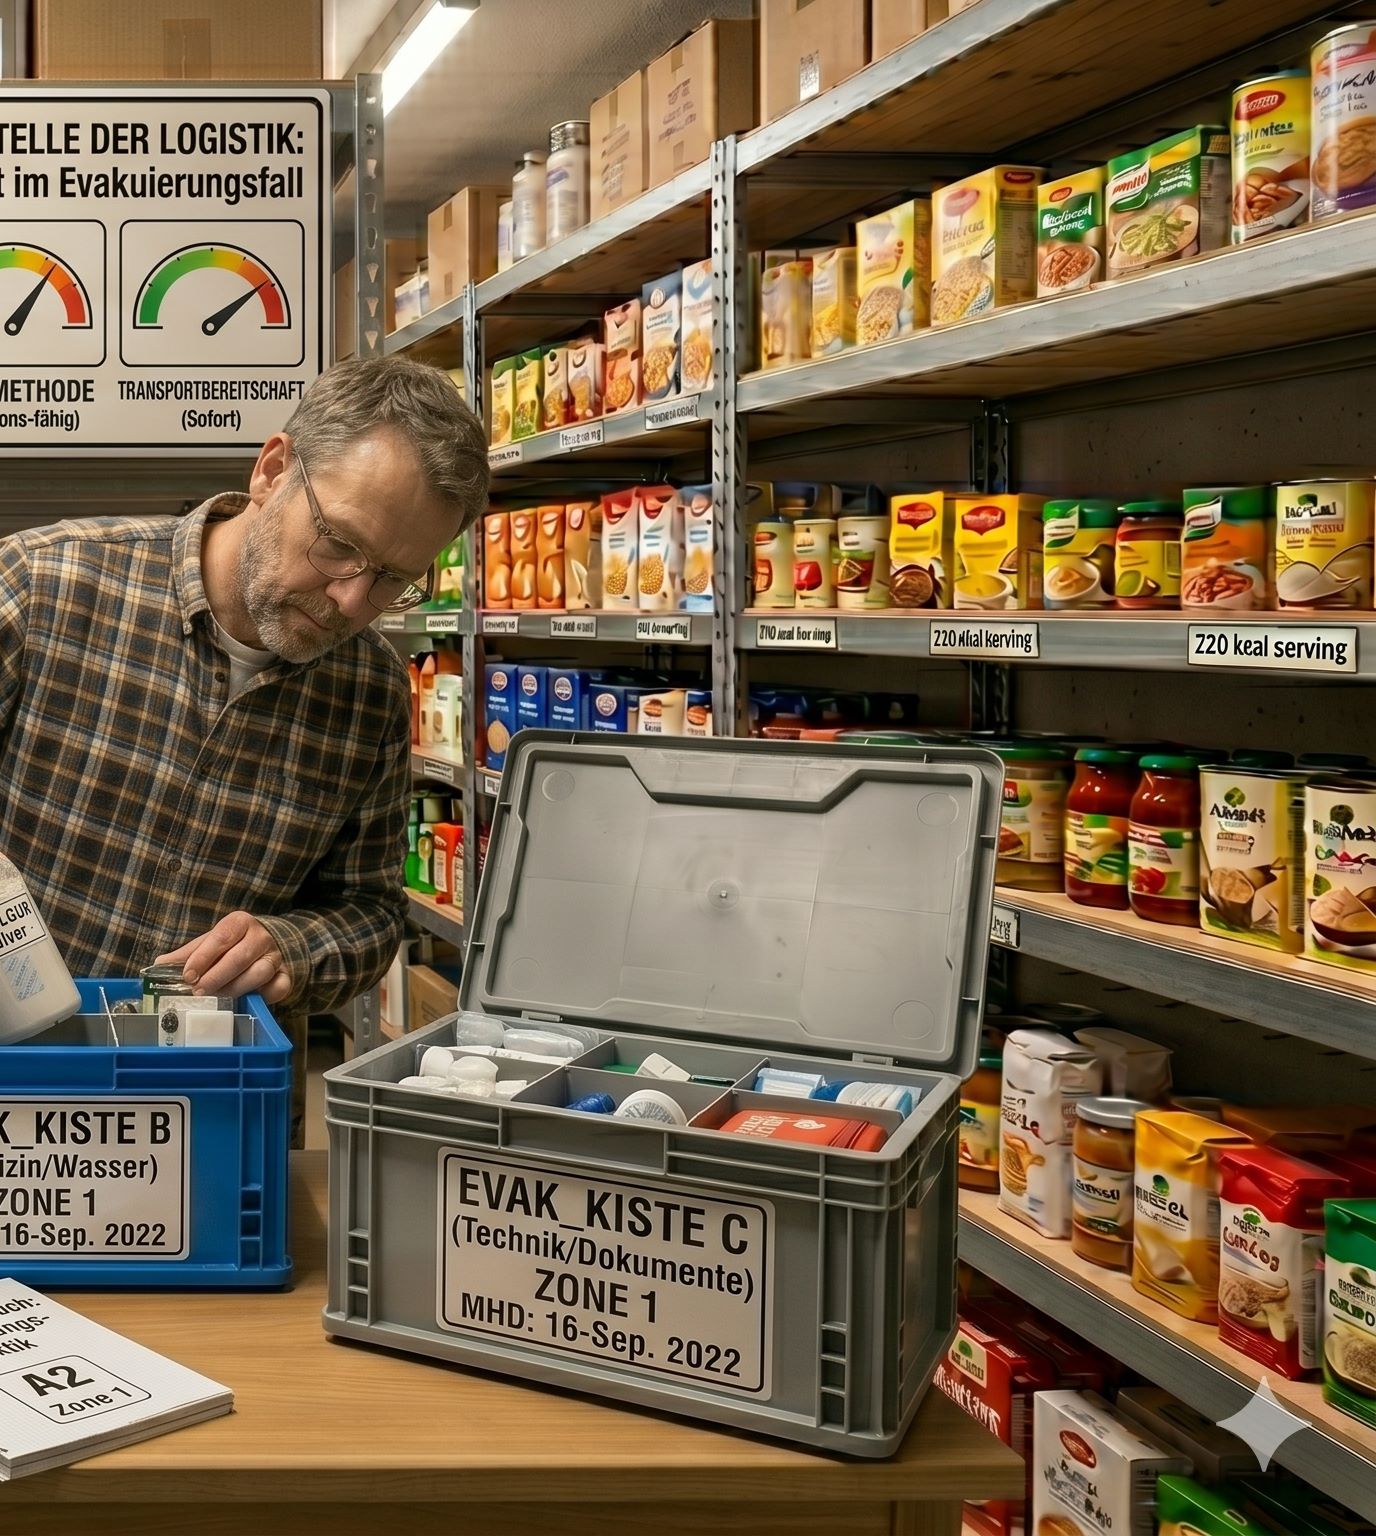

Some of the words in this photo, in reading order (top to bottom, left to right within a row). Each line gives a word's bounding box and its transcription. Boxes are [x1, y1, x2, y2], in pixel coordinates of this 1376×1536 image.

[90, 122, 151, 155] DER
[159, 122, 305, 155] LOGISTIK:
[14, 166, 50, 198] im
[59, 166, 304, 205] Evakuierungsfall
[117, 380, 305, 401] TRANSPORTBEREITSCHAFT
[180, 409, 242, 431] (Sofort)
[1273, 636, 1348, 665] serving
[149, 1110, 171, 1145] B
[82, 1187, 97, 1217] 1
[459, 1166, 706, 1249] EVAK_KISTE
[721, 1212, 749, 1255] C
[0, 1222, 95, 1251] 16-Sep.
[104, 1222, 167, 1247] 2022
[452, 1214, 754, 1304] (Technik/Dokumente)
[534, 1267, 629, 1319] ZONE
[640, 1290, 657, 1324] 1
[461, 1292, 534, 1333] MHD:
[545, 1311, 654, 1361] 16-Sep.
[667, 1336, 741, 1378] 2022
[21, 1364, 96, 1397] A2
[49, 1391, 111, 1418] Zone
[110, 1385, 134, 1401] 1
